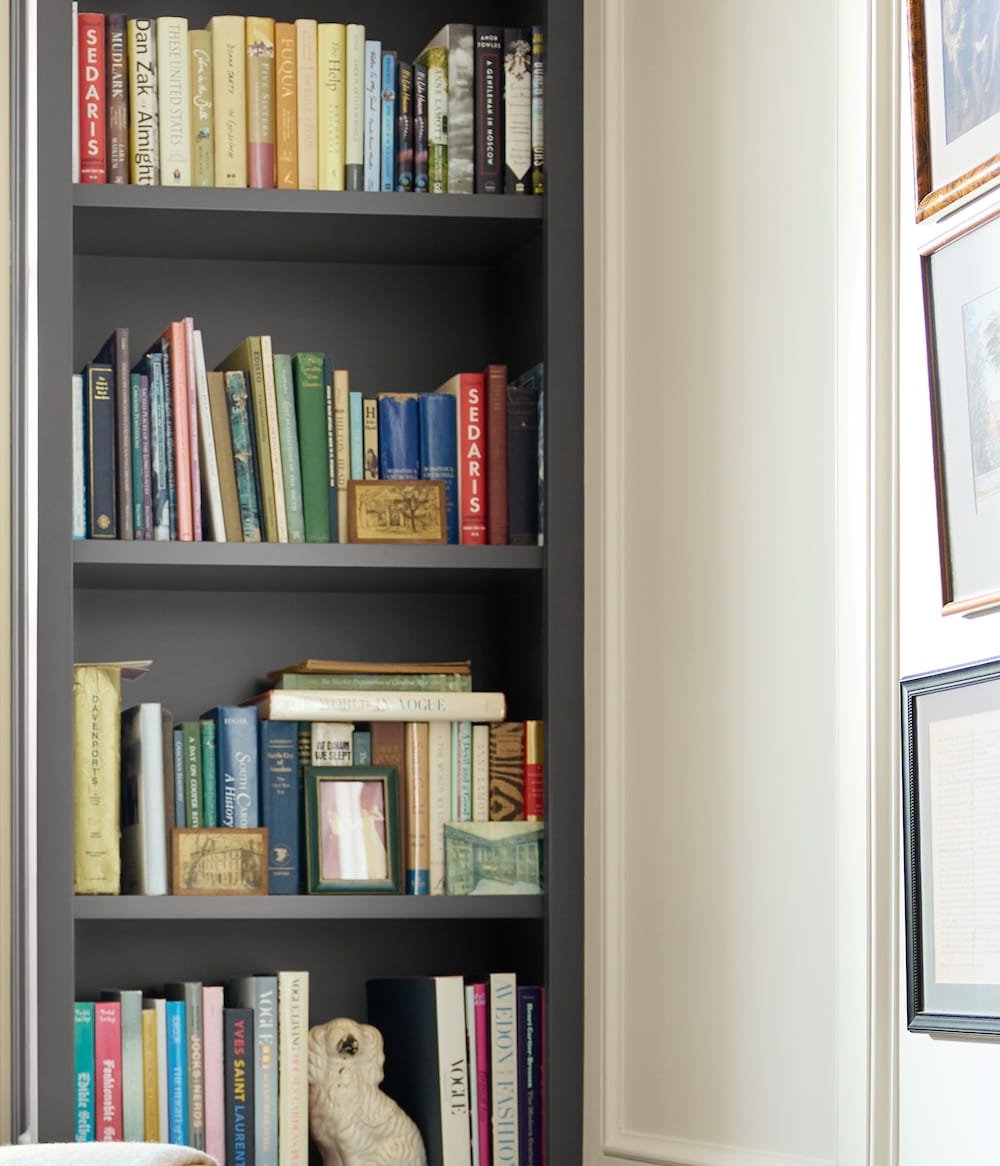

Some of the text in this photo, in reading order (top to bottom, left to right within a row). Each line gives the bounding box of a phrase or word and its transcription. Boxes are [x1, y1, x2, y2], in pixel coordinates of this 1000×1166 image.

[136, 19, 152, 54] Dan
[111, 32, 124, 99] MUDLARK
[137, 61, 153, 96] Zak
[168, 24, 183, 146] THESE UNITED STATES
[279, 39, 294, 97] FUQUA
[325, 60, 341, 92] Help
[85, 29, 101, 157] SEDARIS
[486, 68, 494, 115] GENTLEMAN
[261, 94, 270, 137] SISTERS
[486, 117, 494, 126] IN
[486, 129, 494, 166] MOSCOW
[253, 352, 262, 383] EDISTO
[336, 417, 345, 486] HILTON HEAD
[467, 388, 481, 513] SEDARIS
[399, 698, 447, 712] VOGUE
[91, 695, 99, 785] DAVENPORTS
[329, 751, 351, 760] SLEPT
[190, 764, 197, 776] ON
[235, 752, 251, 790] SOUTH
[222, 773, 236, 827] A History
[290, 978, 301, 1012] VOGUE
[526, 1003, 534, 1025] Henri
[234, 1020, 245, 1055] YVES
[258, 990, 273, 1045] VOGUE
[290, 1015, 301, 1050] LIVING
[191, 1034, 202, 1128] JOCKS NERDS
[234, 1060, 246, 1102] SAINT
[451, 1059, 466, 1115] VOGUE
